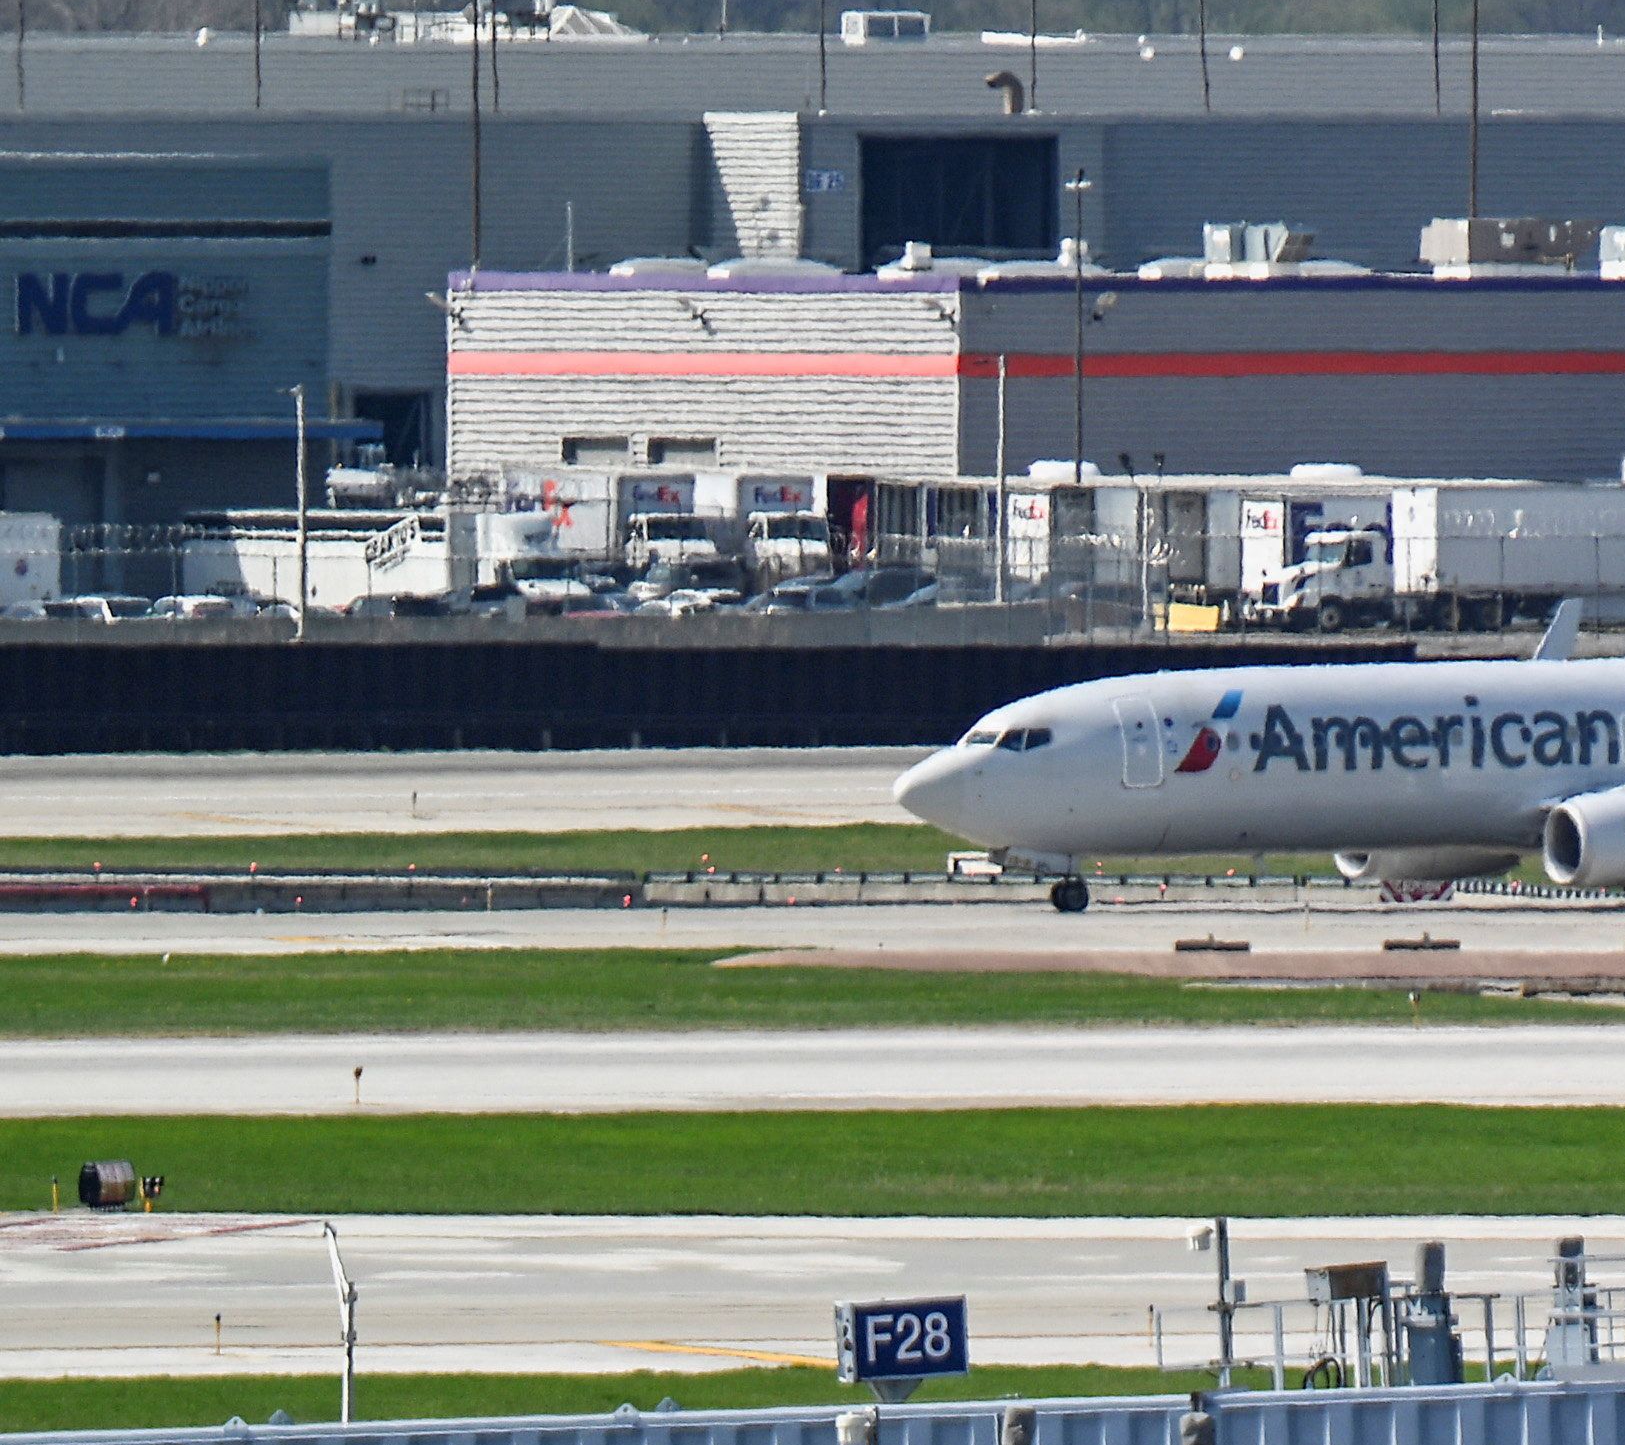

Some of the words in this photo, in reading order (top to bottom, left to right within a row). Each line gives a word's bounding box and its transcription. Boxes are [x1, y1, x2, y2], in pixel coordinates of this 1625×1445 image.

[15, 271, 178, 336] NCA
[1254, 695, 1621, 772] American
[865, 1312, 951, 1363] F28
